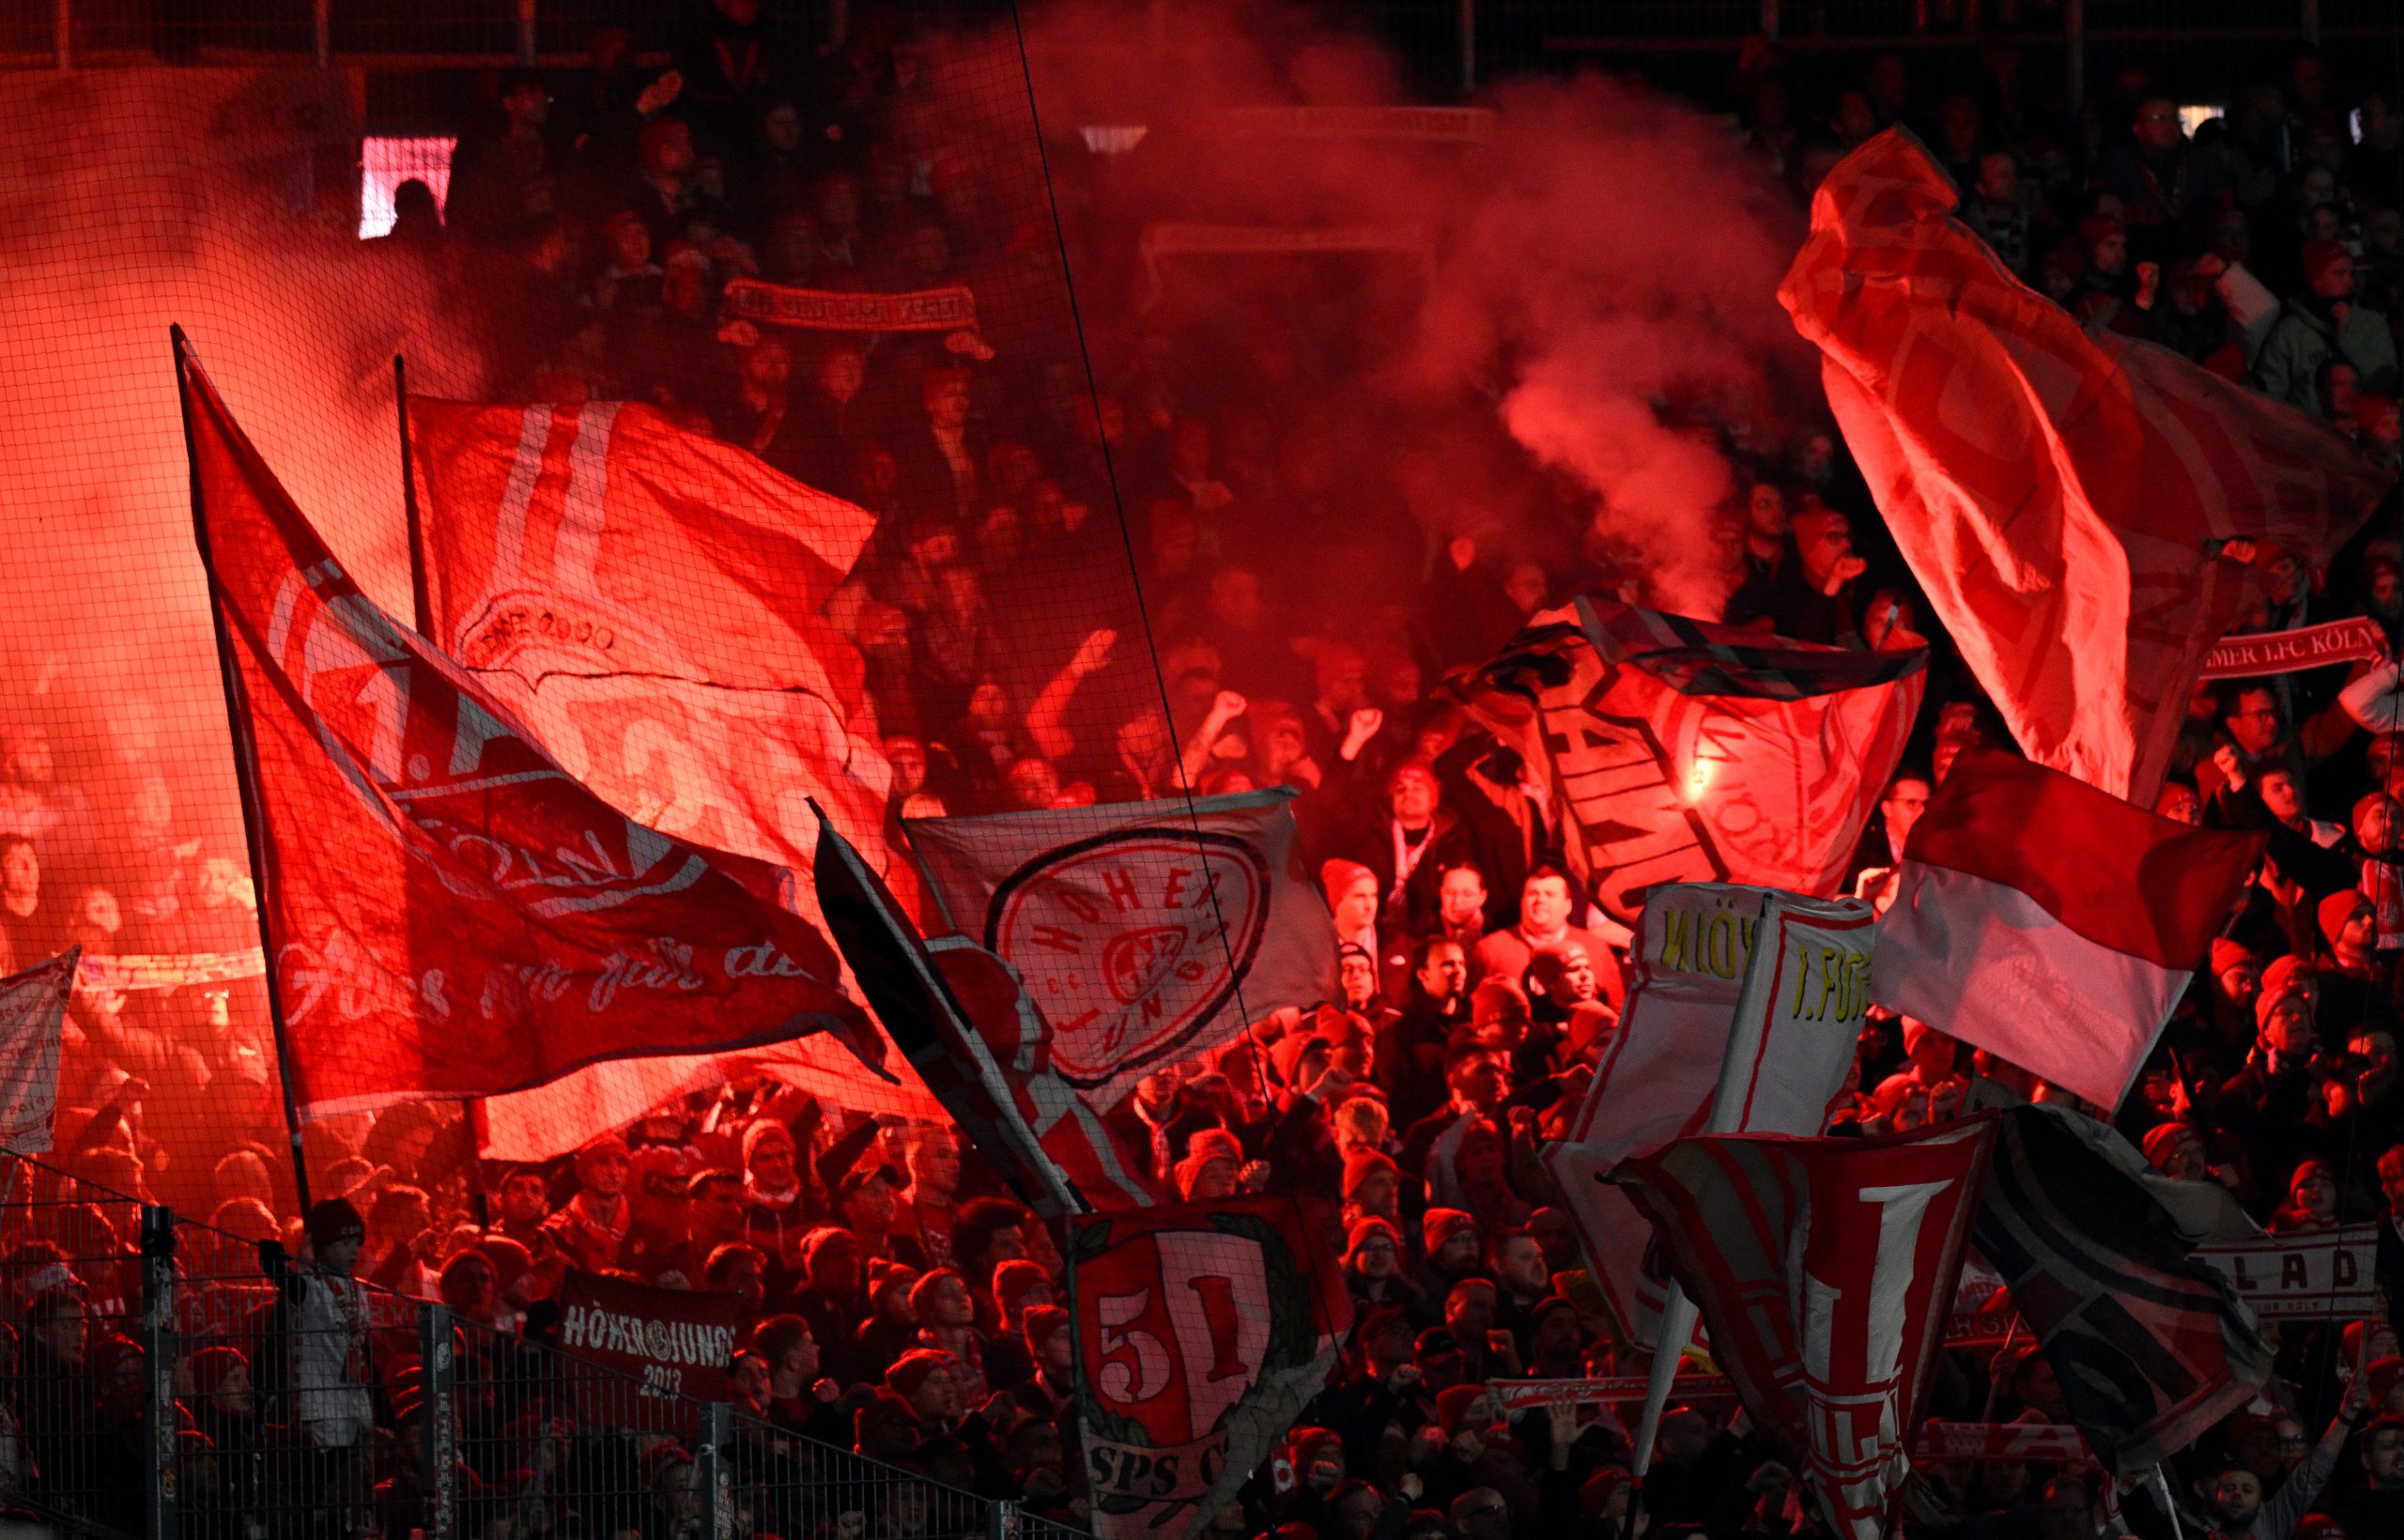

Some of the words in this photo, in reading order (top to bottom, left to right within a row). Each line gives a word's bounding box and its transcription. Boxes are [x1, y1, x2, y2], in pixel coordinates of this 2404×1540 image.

[2264, 638, 2306, 663] 1.FC
[562, 1299, 651, 1359] HÖHER
[1091, 1445, 1181, 1497] SPS
